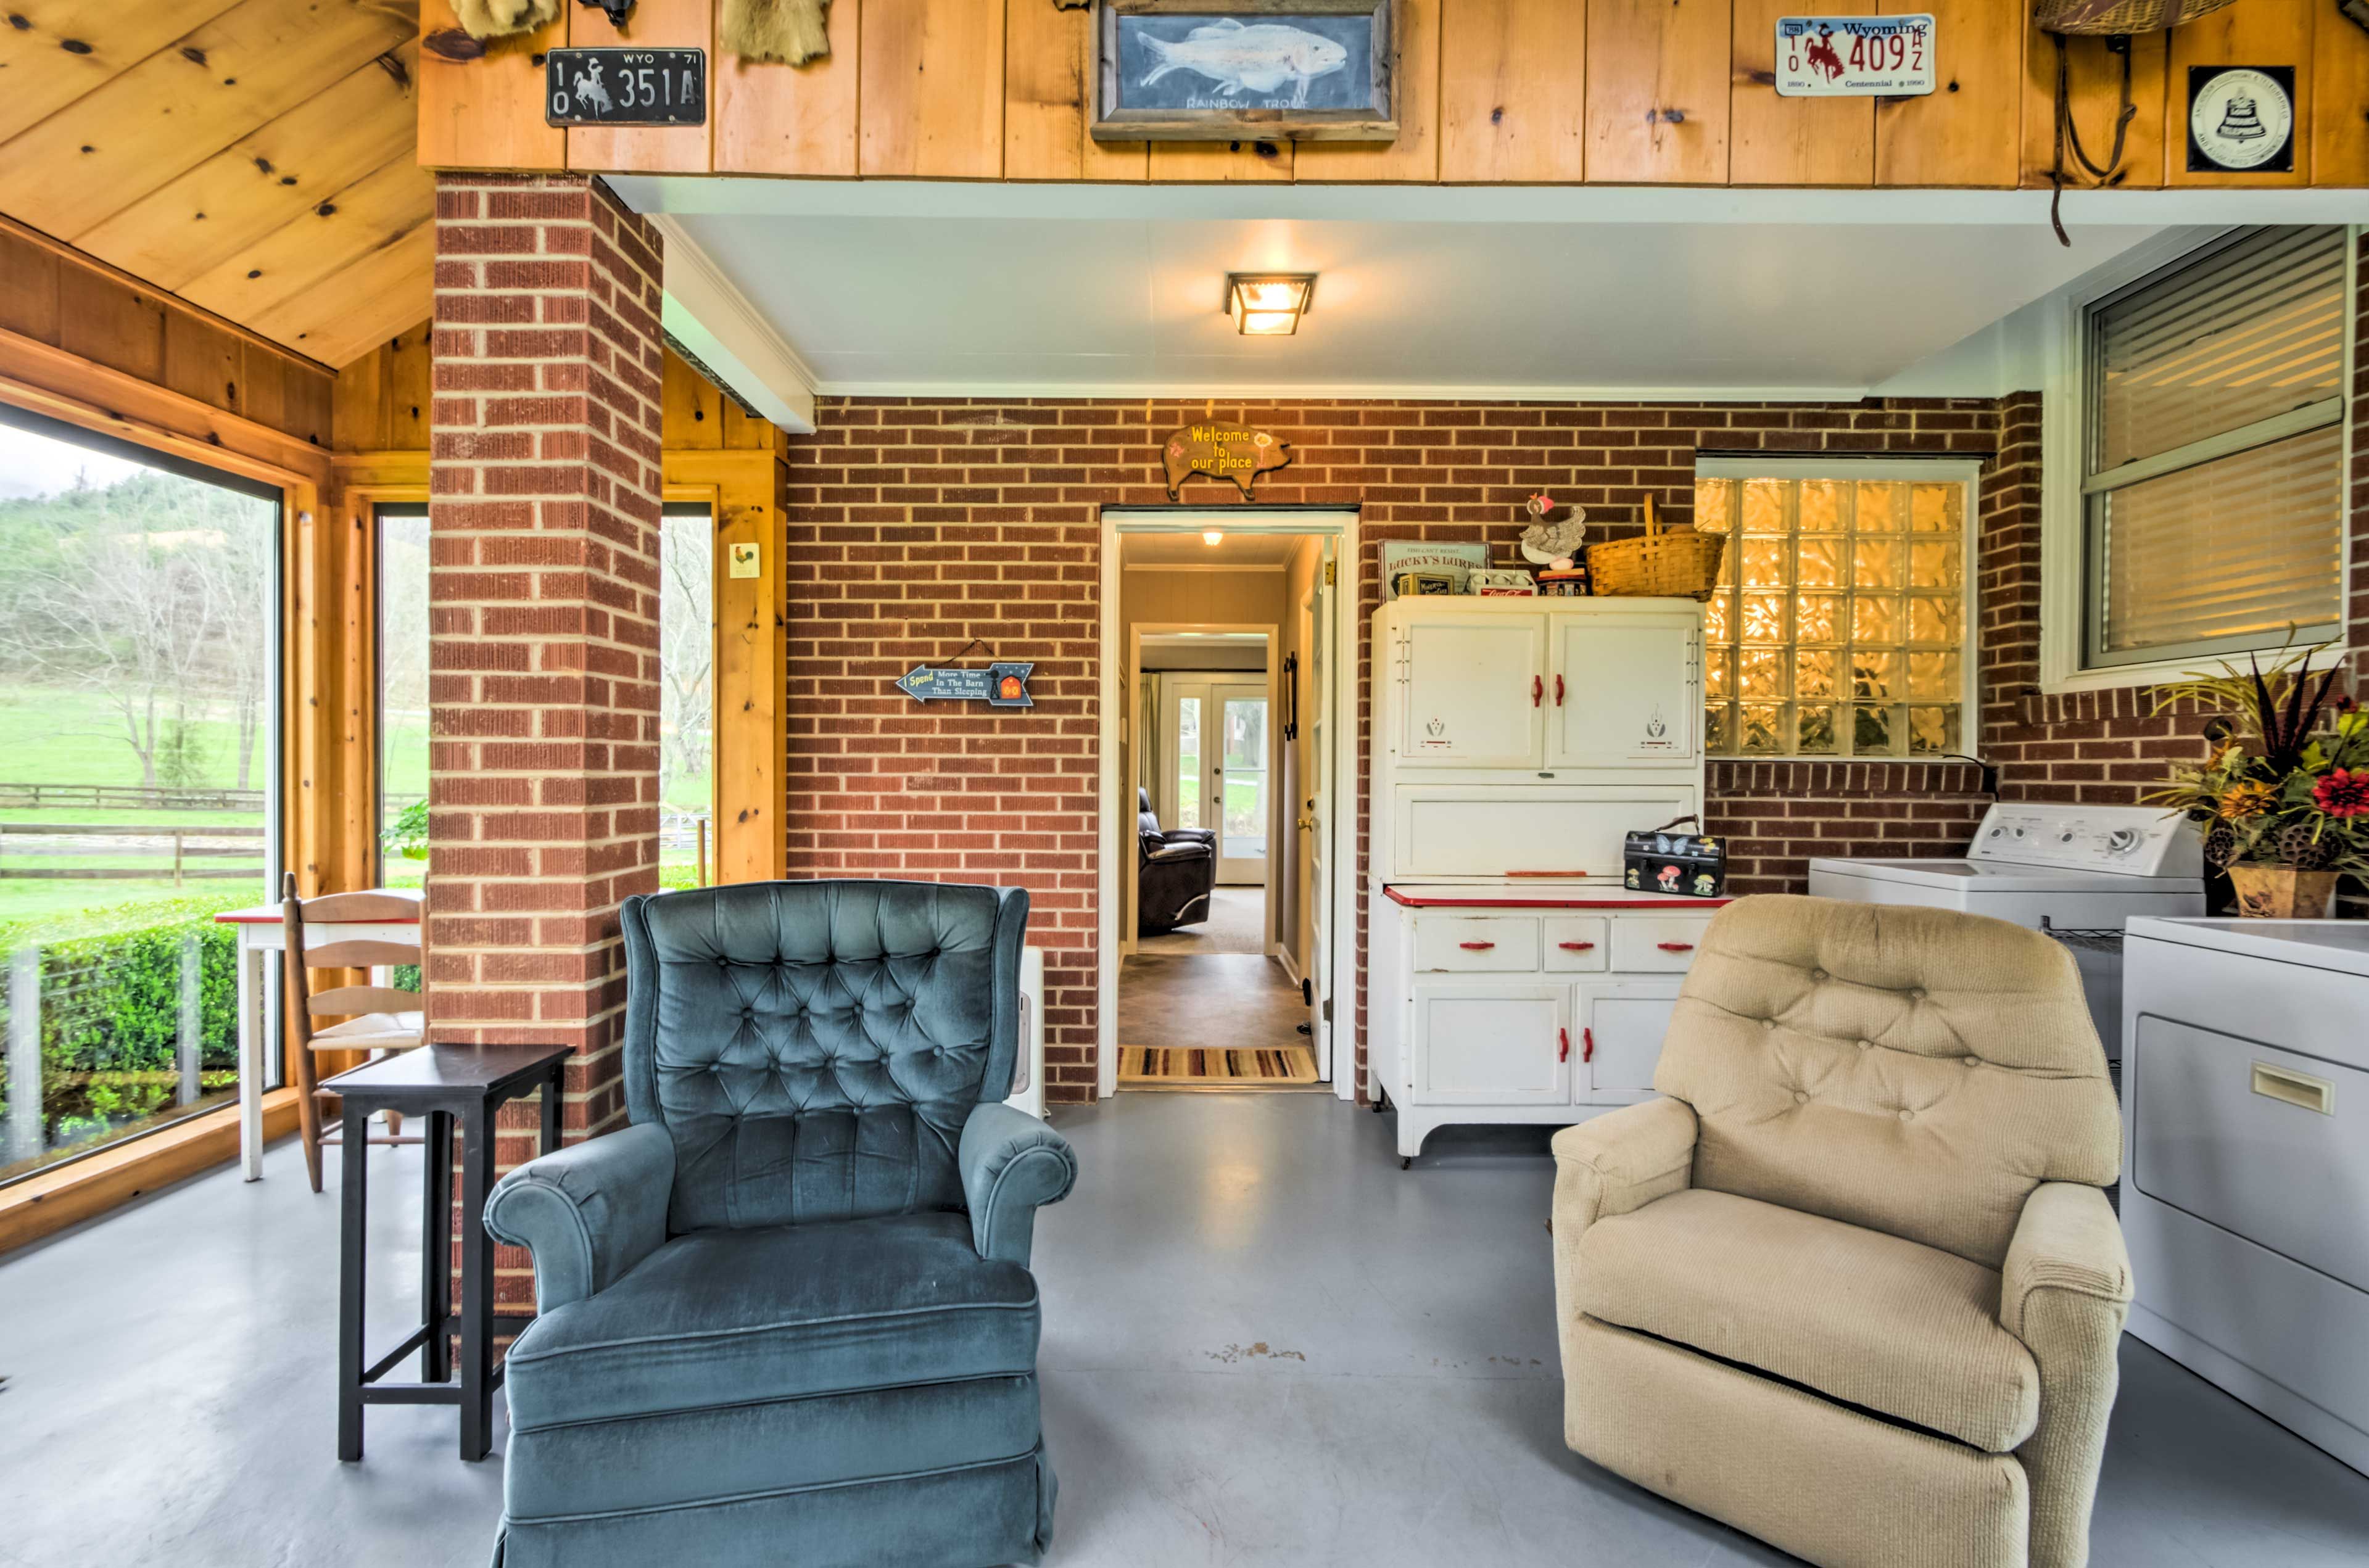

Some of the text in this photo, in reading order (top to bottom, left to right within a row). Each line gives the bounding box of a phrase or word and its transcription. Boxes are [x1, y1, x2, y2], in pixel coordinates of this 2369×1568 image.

[1843, 22, 1928, 38] Wyoming
[623, 54, 655, 64] WYO
[684, 54, 697, 64] 71
[1848, 34, 1905, 72] 409
[618, 68, 696, 108] 351A
[1186, 98, 1309, 109] RAINBOW TROUT
[1191, 426, 1249, 442] Welcome
[1213, 442, 1225, 458] to
[1191, 452, 1252, 474] our place
[1389, 555, 1482, 571] LUCKY'S LURES
[903, 671, 934, 687] I Spend
[954, 687, 987, 697] Sleeping
